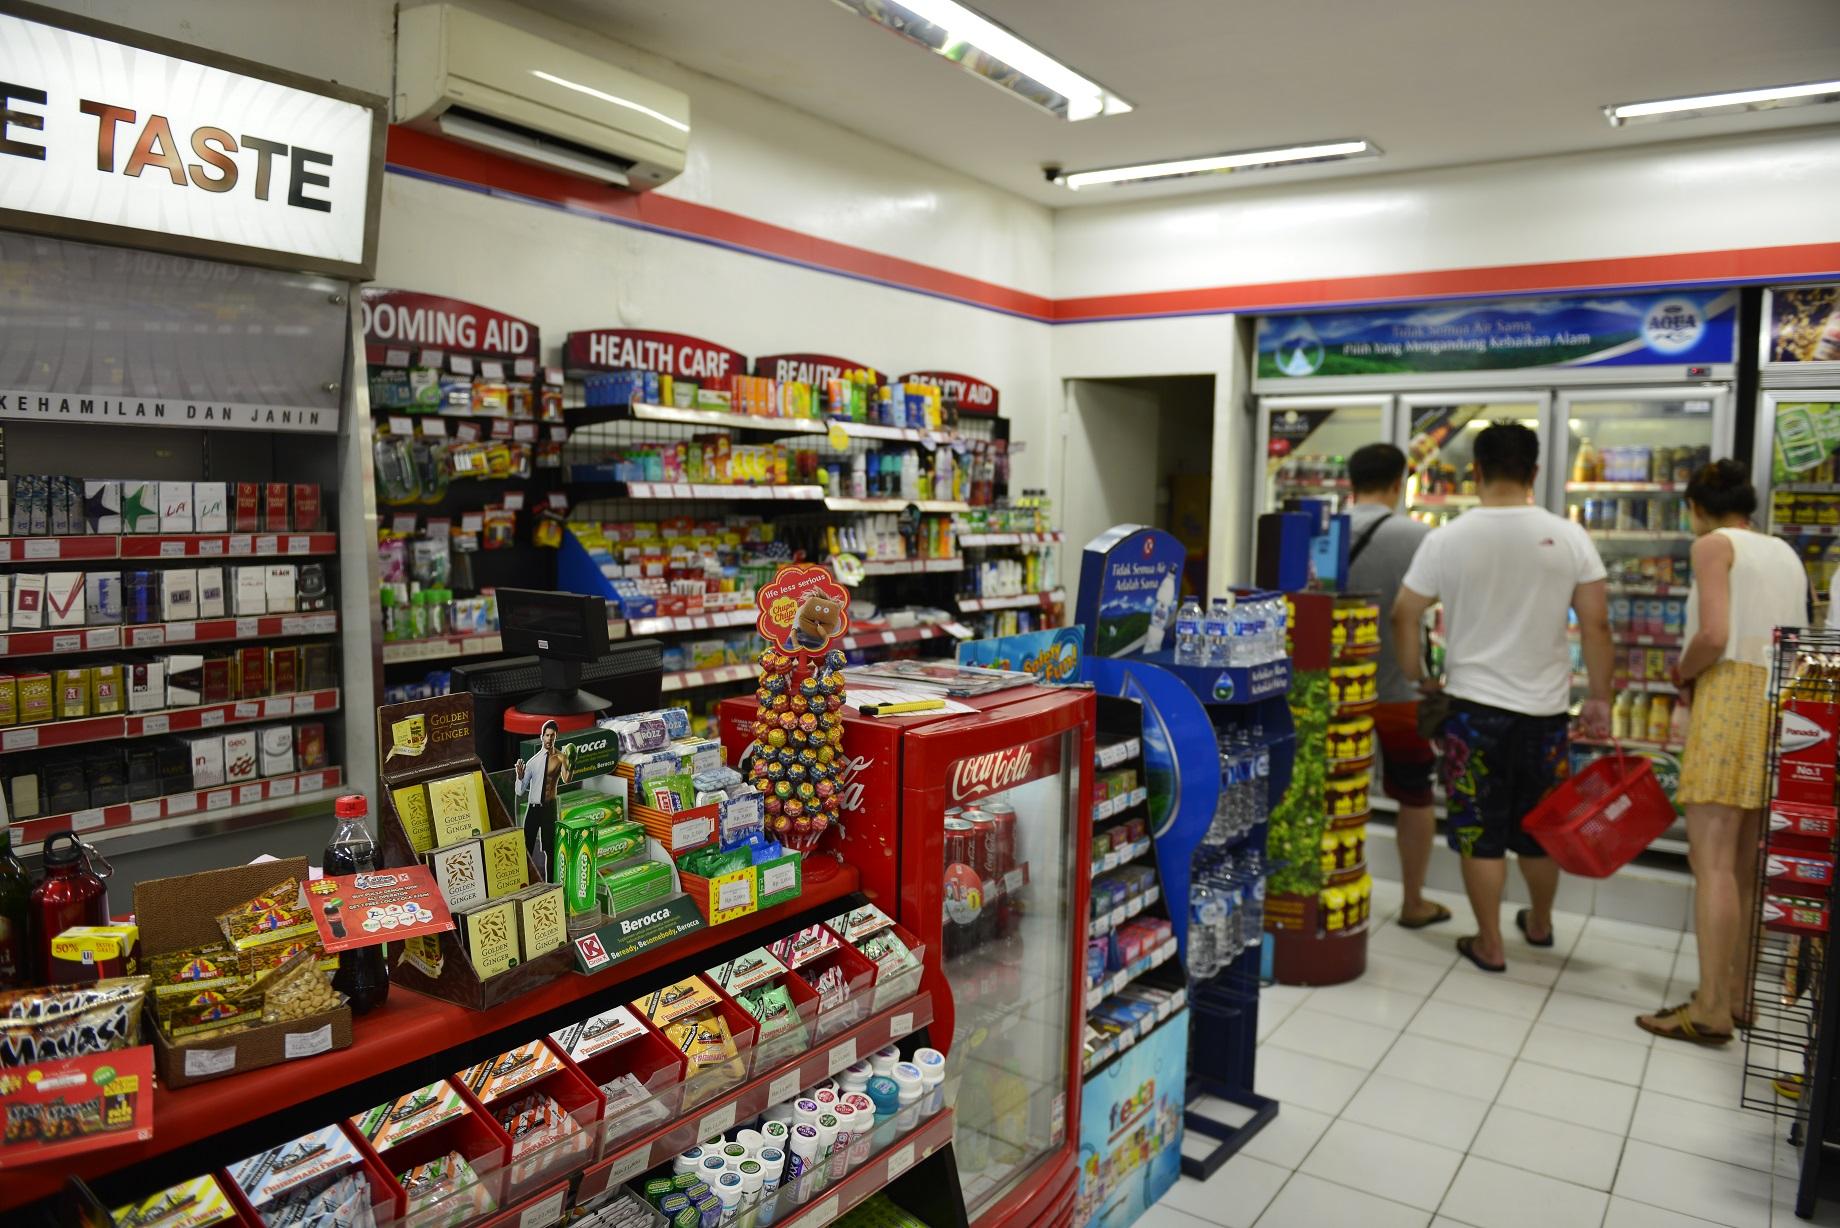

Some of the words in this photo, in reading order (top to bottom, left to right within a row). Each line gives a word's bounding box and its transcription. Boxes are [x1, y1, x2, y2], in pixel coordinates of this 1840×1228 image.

[79, 98, 334, 213] TASTE
[483, 317, 528, 354] AID
[1489, 334, 1551, 350] Kebaikan
[1554, 332, 1591, 346] Alam
[589, 332, 673, 374] HEALTH
[968, 384, 993, 405] AID
[187, 404, 232, 421] DAN
[251, 408, 319, 425] JANIN
[765, 590, 779, 600] life
[780, 584, 796, 594] less
[798, 574, 826, 588] serious
[773, 601, 795, 616] Chupa
[774, 609, 797, 624] Chups
[430, 711, 469, 726] GOLDEN
[431, 727, 470, 743] GINGER
[1785, 727, 1820, 737] Panadol
[597, 760, 615, 769] Berocca
[952, 744, 1032, 801] Coca-Cola
[444, 812, 471, 824] GOLDEN
[446, 823, 472, 835] GINGER
[495, 868, 520, 880] GOLDEN
[578, 854, 588, 898] Berocca
[448, 881, 475, 895] GOLDEN
[496, 878, 521, 890] GINGER
[450, 892, 477, 906] GINGER
[620, 908, 671, 934] Berocca
[534, 926, 559, 941] GOLDEN
[611, 944, 639, 960] Beready,
[638, 928, 678, 948] Besomebody,
[676, 919, 700, 932] Berocca
[55, 942, 79, 953] 50%
[481, 943, 508, 957] GOLDEN
[535, 936, 560, 951] GINGER
[482, 953, 510, 968] GINGER
[589, 957, 602, 966] Circle
[618, 1025, 641, 1040] FRIEND
[531, 1062, 557, 1077] FRIEND
[433, 1105, 463, 1121] FRIEND
[319, 1153, 352, 1170] FRIEND
